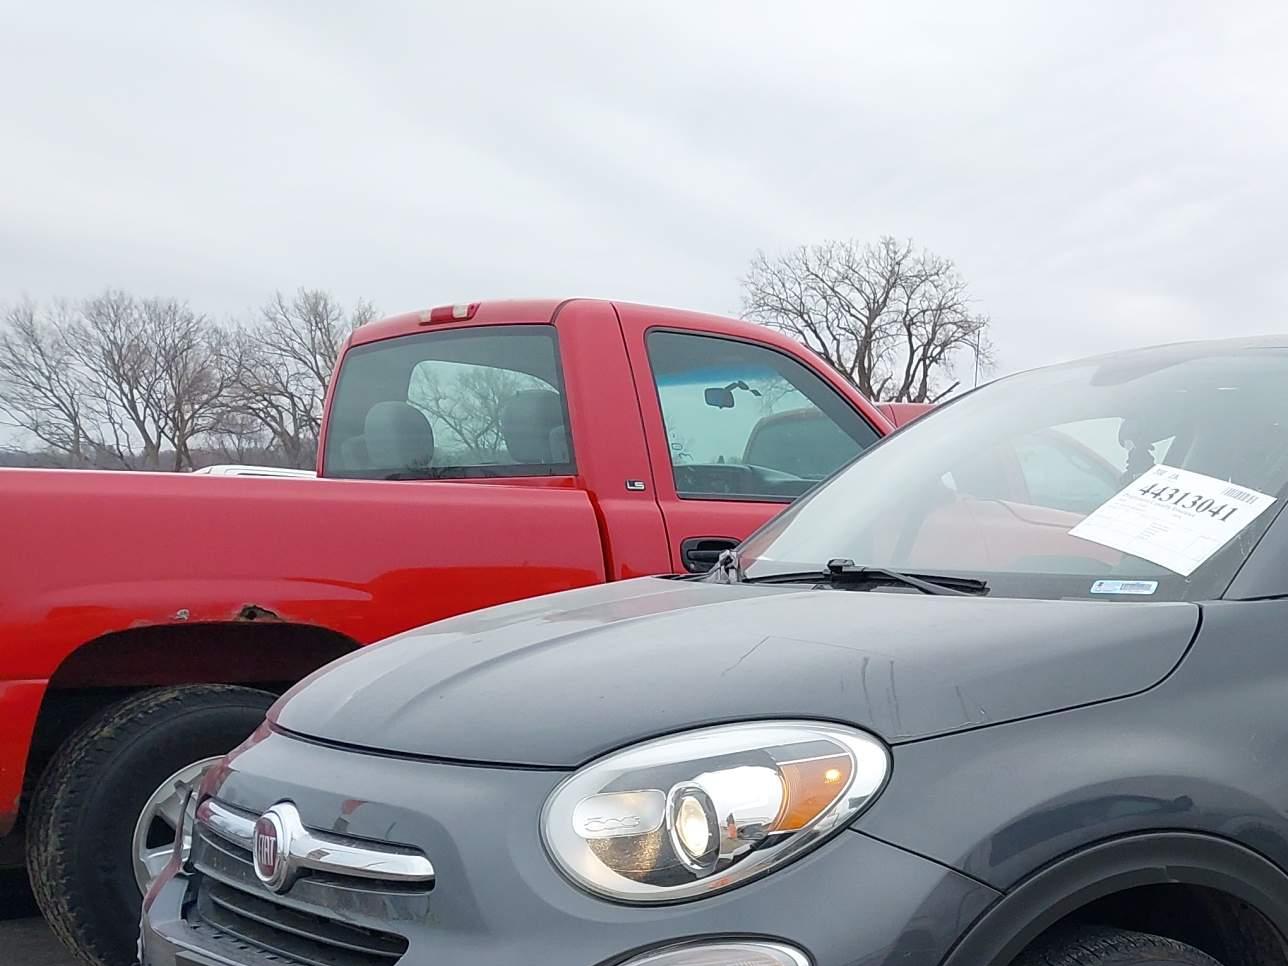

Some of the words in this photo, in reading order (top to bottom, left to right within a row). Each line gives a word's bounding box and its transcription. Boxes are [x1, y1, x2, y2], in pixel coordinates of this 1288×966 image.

[626, 479, 645, 490] LS
[1138, 483, 1239, 522] 44313041
[257, 832, 276, 867] FIAT
